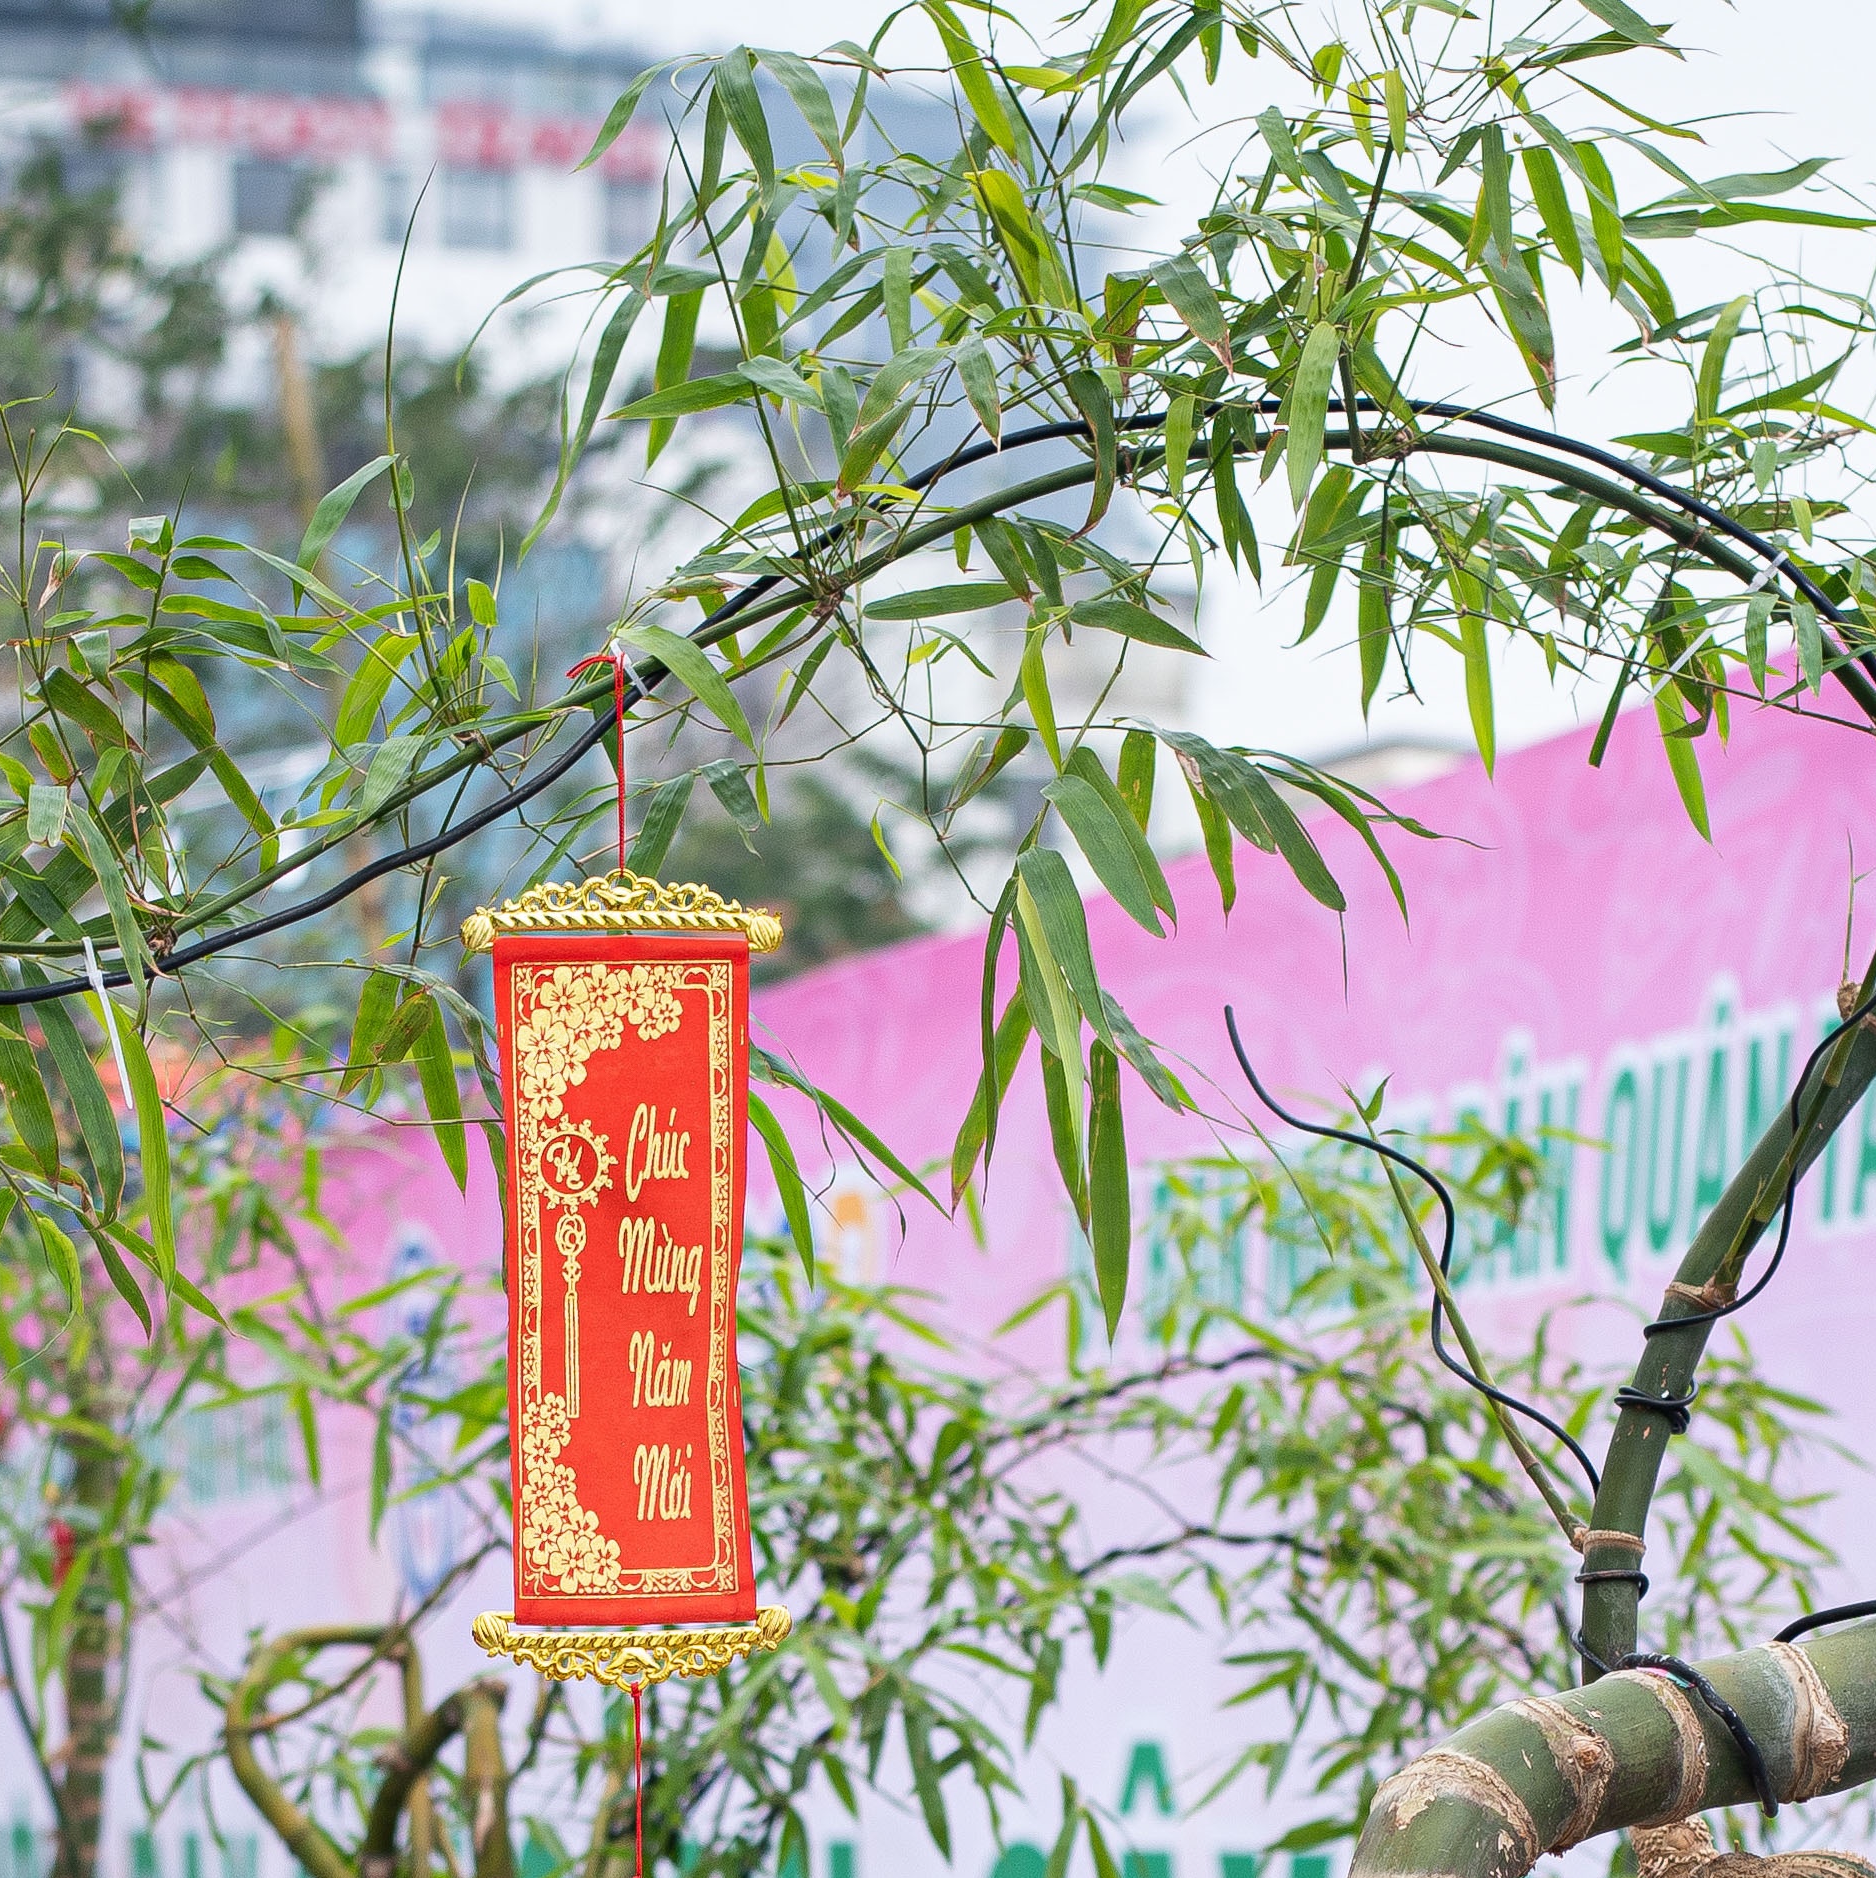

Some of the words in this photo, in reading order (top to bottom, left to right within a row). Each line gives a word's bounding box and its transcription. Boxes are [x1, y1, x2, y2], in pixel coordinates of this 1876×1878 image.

[626, 1103, 691, 1203] Chúc
[618, 1216, 704, 1317] Mừng
[628, 1330, 692, 1409] Năm
[633, 1443, 693, 1521] Mới
